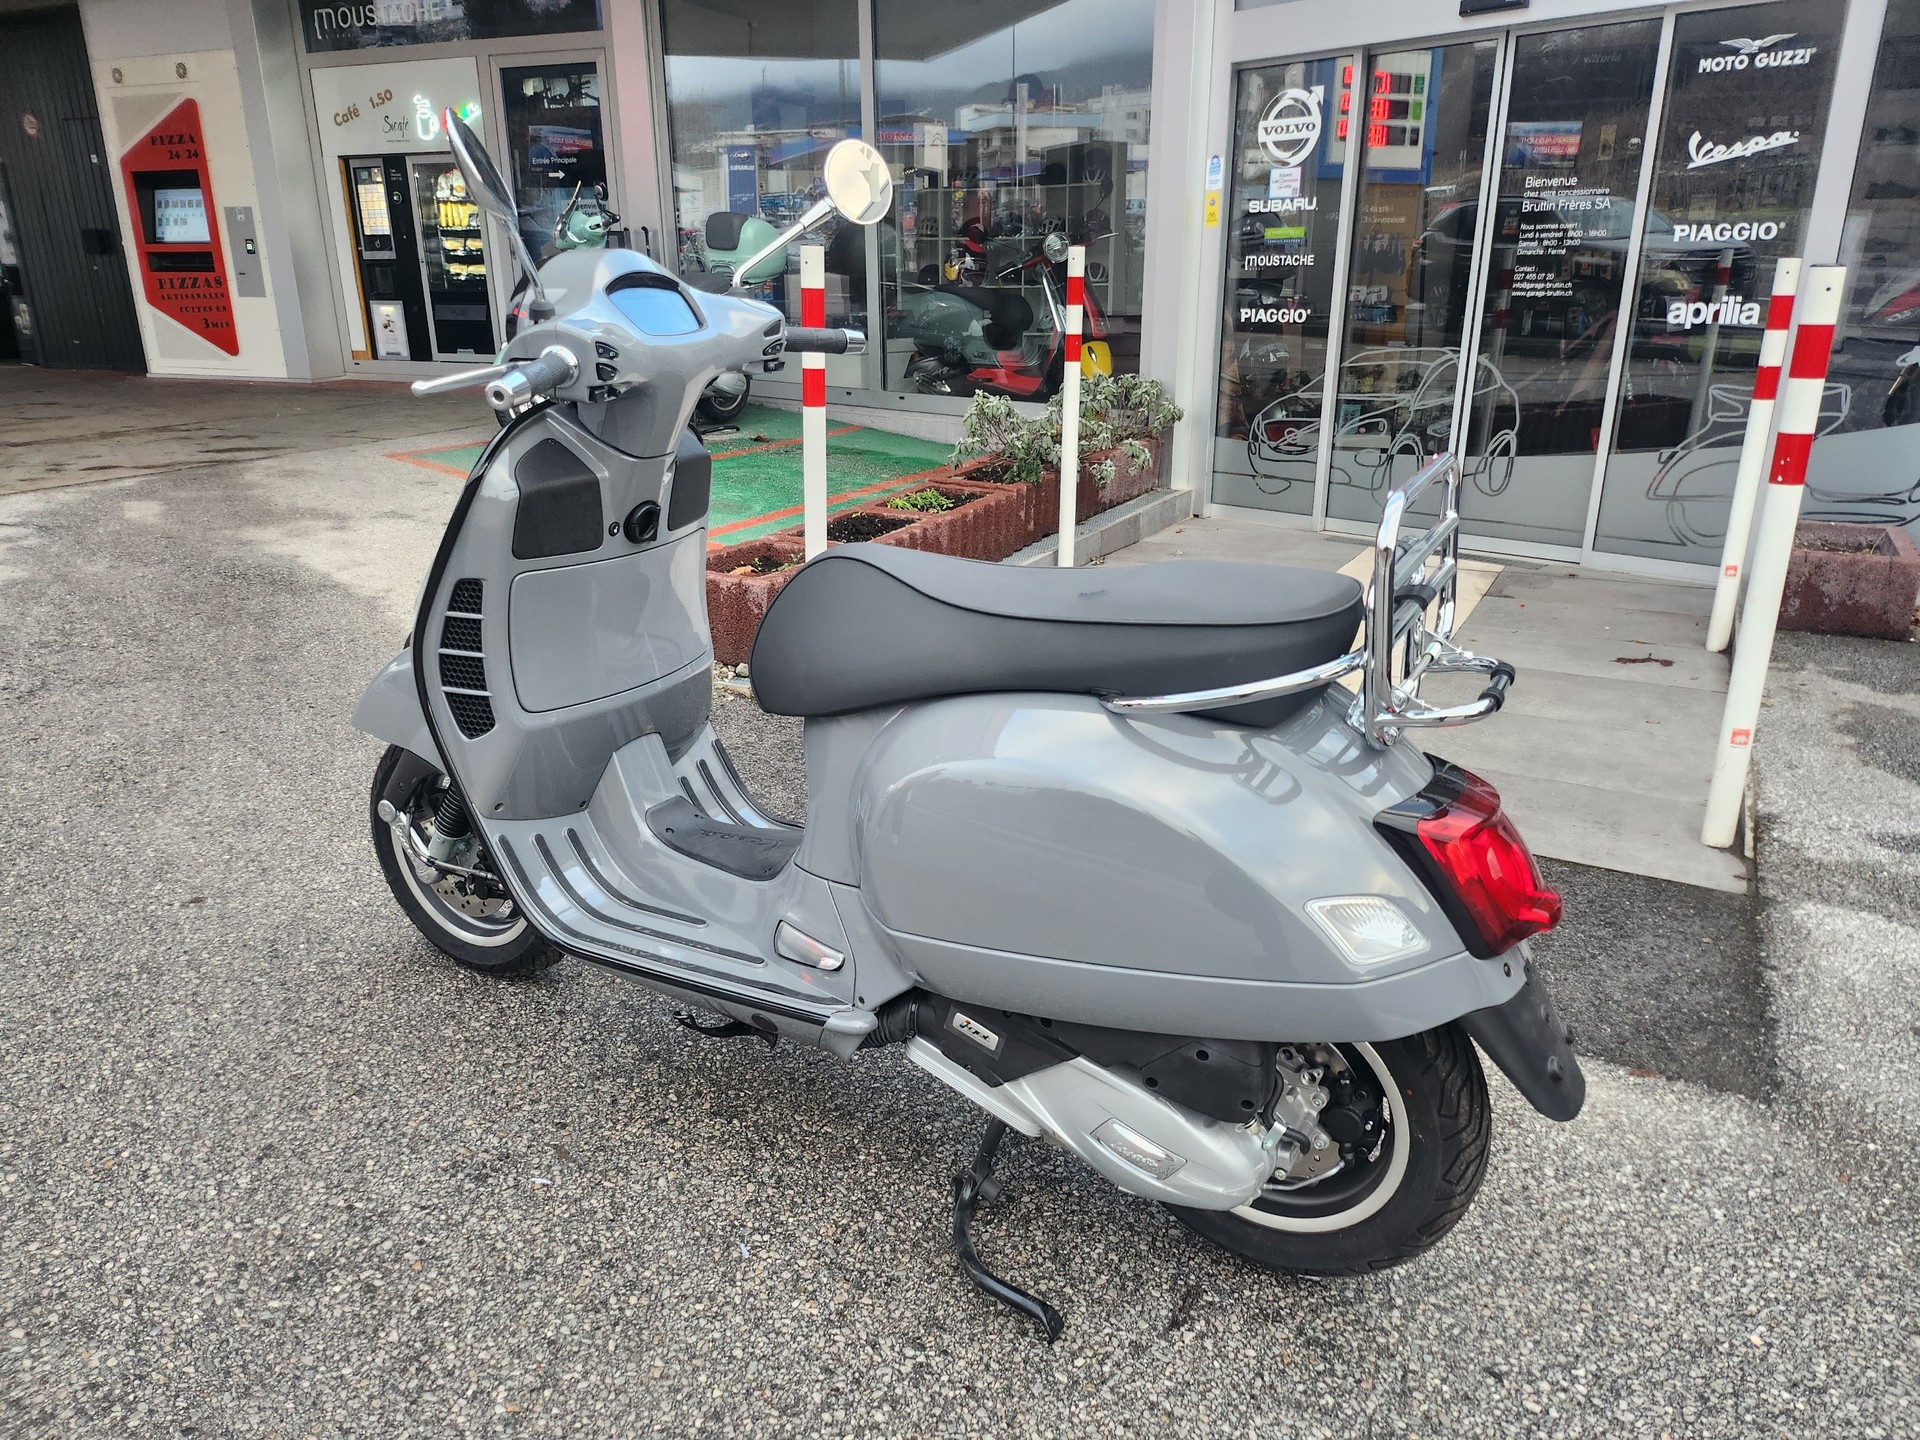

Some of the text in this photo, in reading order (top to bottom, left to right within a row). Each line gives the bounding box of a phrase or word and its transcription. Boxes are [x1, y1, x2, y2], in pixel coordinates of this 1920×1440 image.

[314, 1, 442, 39] MOUSTACHE
[1698, 55, 1749, 73] MOTO
[334, 89, 393, 127] Café 1.50
[1262, 122, 1316, 137] VOLVO
[150, 134, 196, 146] PIZZA
[168, 149, 199, 160] 24 24
[1687, 131, 1799, 169] Vespa
[532, 156, 577, 166] Entrée Principale
[1525, 176, 1578, 188] Bienvenue
[1523, 187, 1610, 198] chez votre concessionnaire
[1248, 197, 1316, 213] SUBARU
[1522, 197, 1611, 213] Bruttin Frères SA
[1540, 231, 1563, 239] vendredi
[1588, 229, 1607, 237] 18h00
[1673, 222, 1778, 242] PIAGGIO
[1517, 248, 1544, 256] Dimanche
[1244, 254, 1315, 270] MOUSTACHE
[157, 276, 223, 290] PIZZAS
[160, 292, 225, 301] ARTISANALES
[1511, 290, 1573, 298] www.garage-bruttin.ch
[216, 305, 227, 313] EN
[1240, 308, 1307, 323] PIAGGIO
[1667, 295, 1761, 330] aprilia
